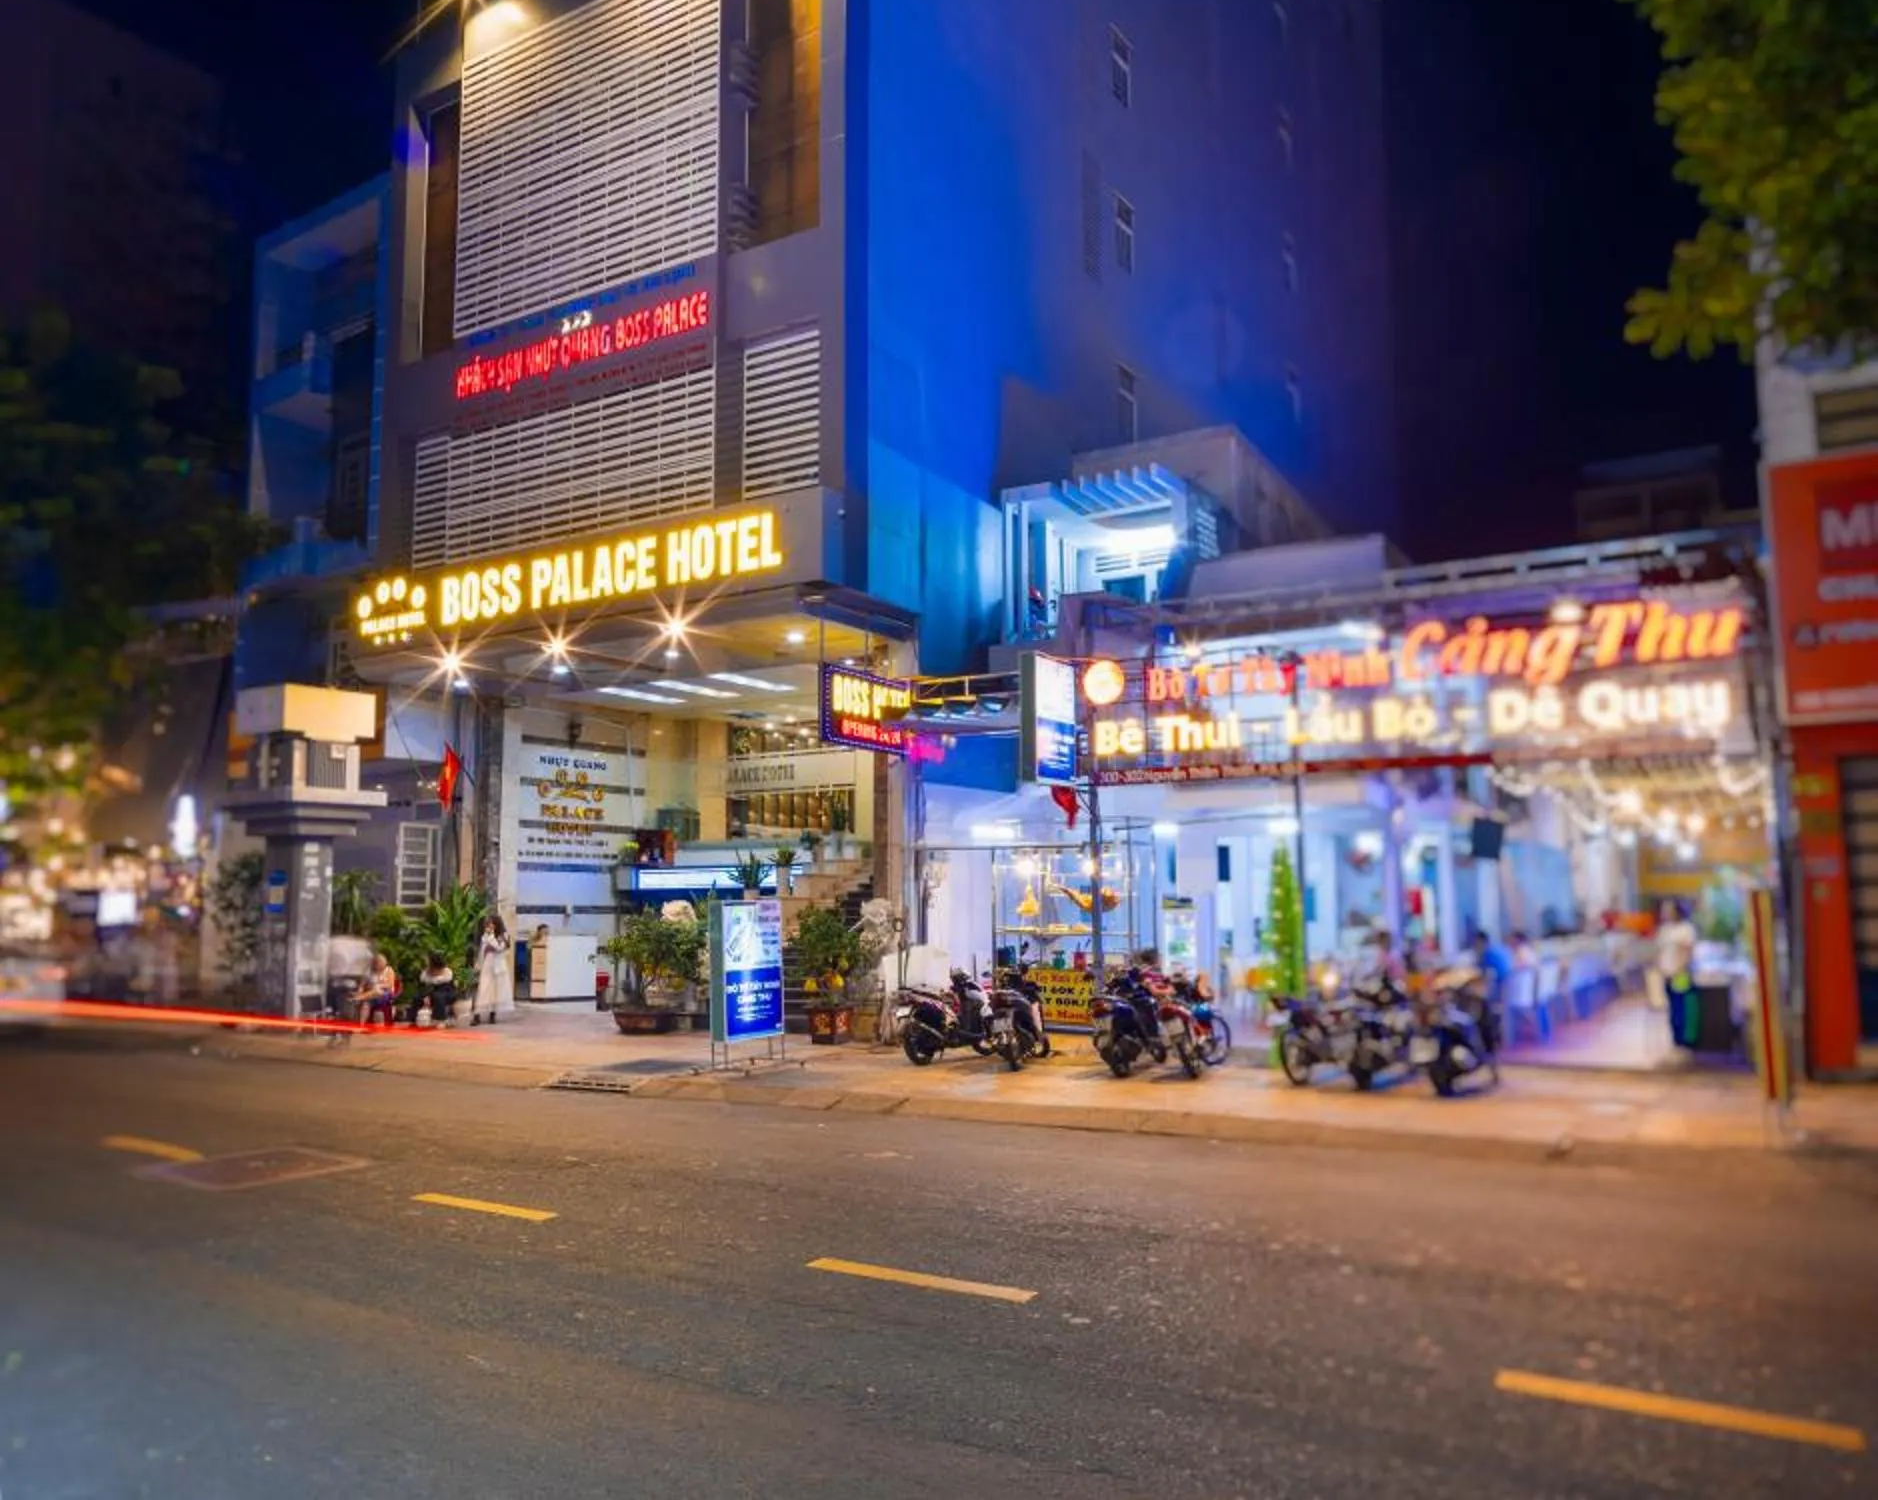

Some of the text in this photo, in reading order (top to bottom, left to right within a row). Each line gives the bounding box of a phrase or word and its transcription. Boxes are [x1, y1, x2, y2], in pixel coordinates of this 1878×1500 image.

[615, 310, 649, 351] BOSS
[652, 291, 709, 339] PALACE
[440, 511, 783, 627] BOSS PALACE HOTEL
[1589, 600, 1743, 668] Thu
[833, 673, 870, 718] BOSS
[1155, 709, 1242, 752] Thui
[1577, 679, 1731, 740] Quay
